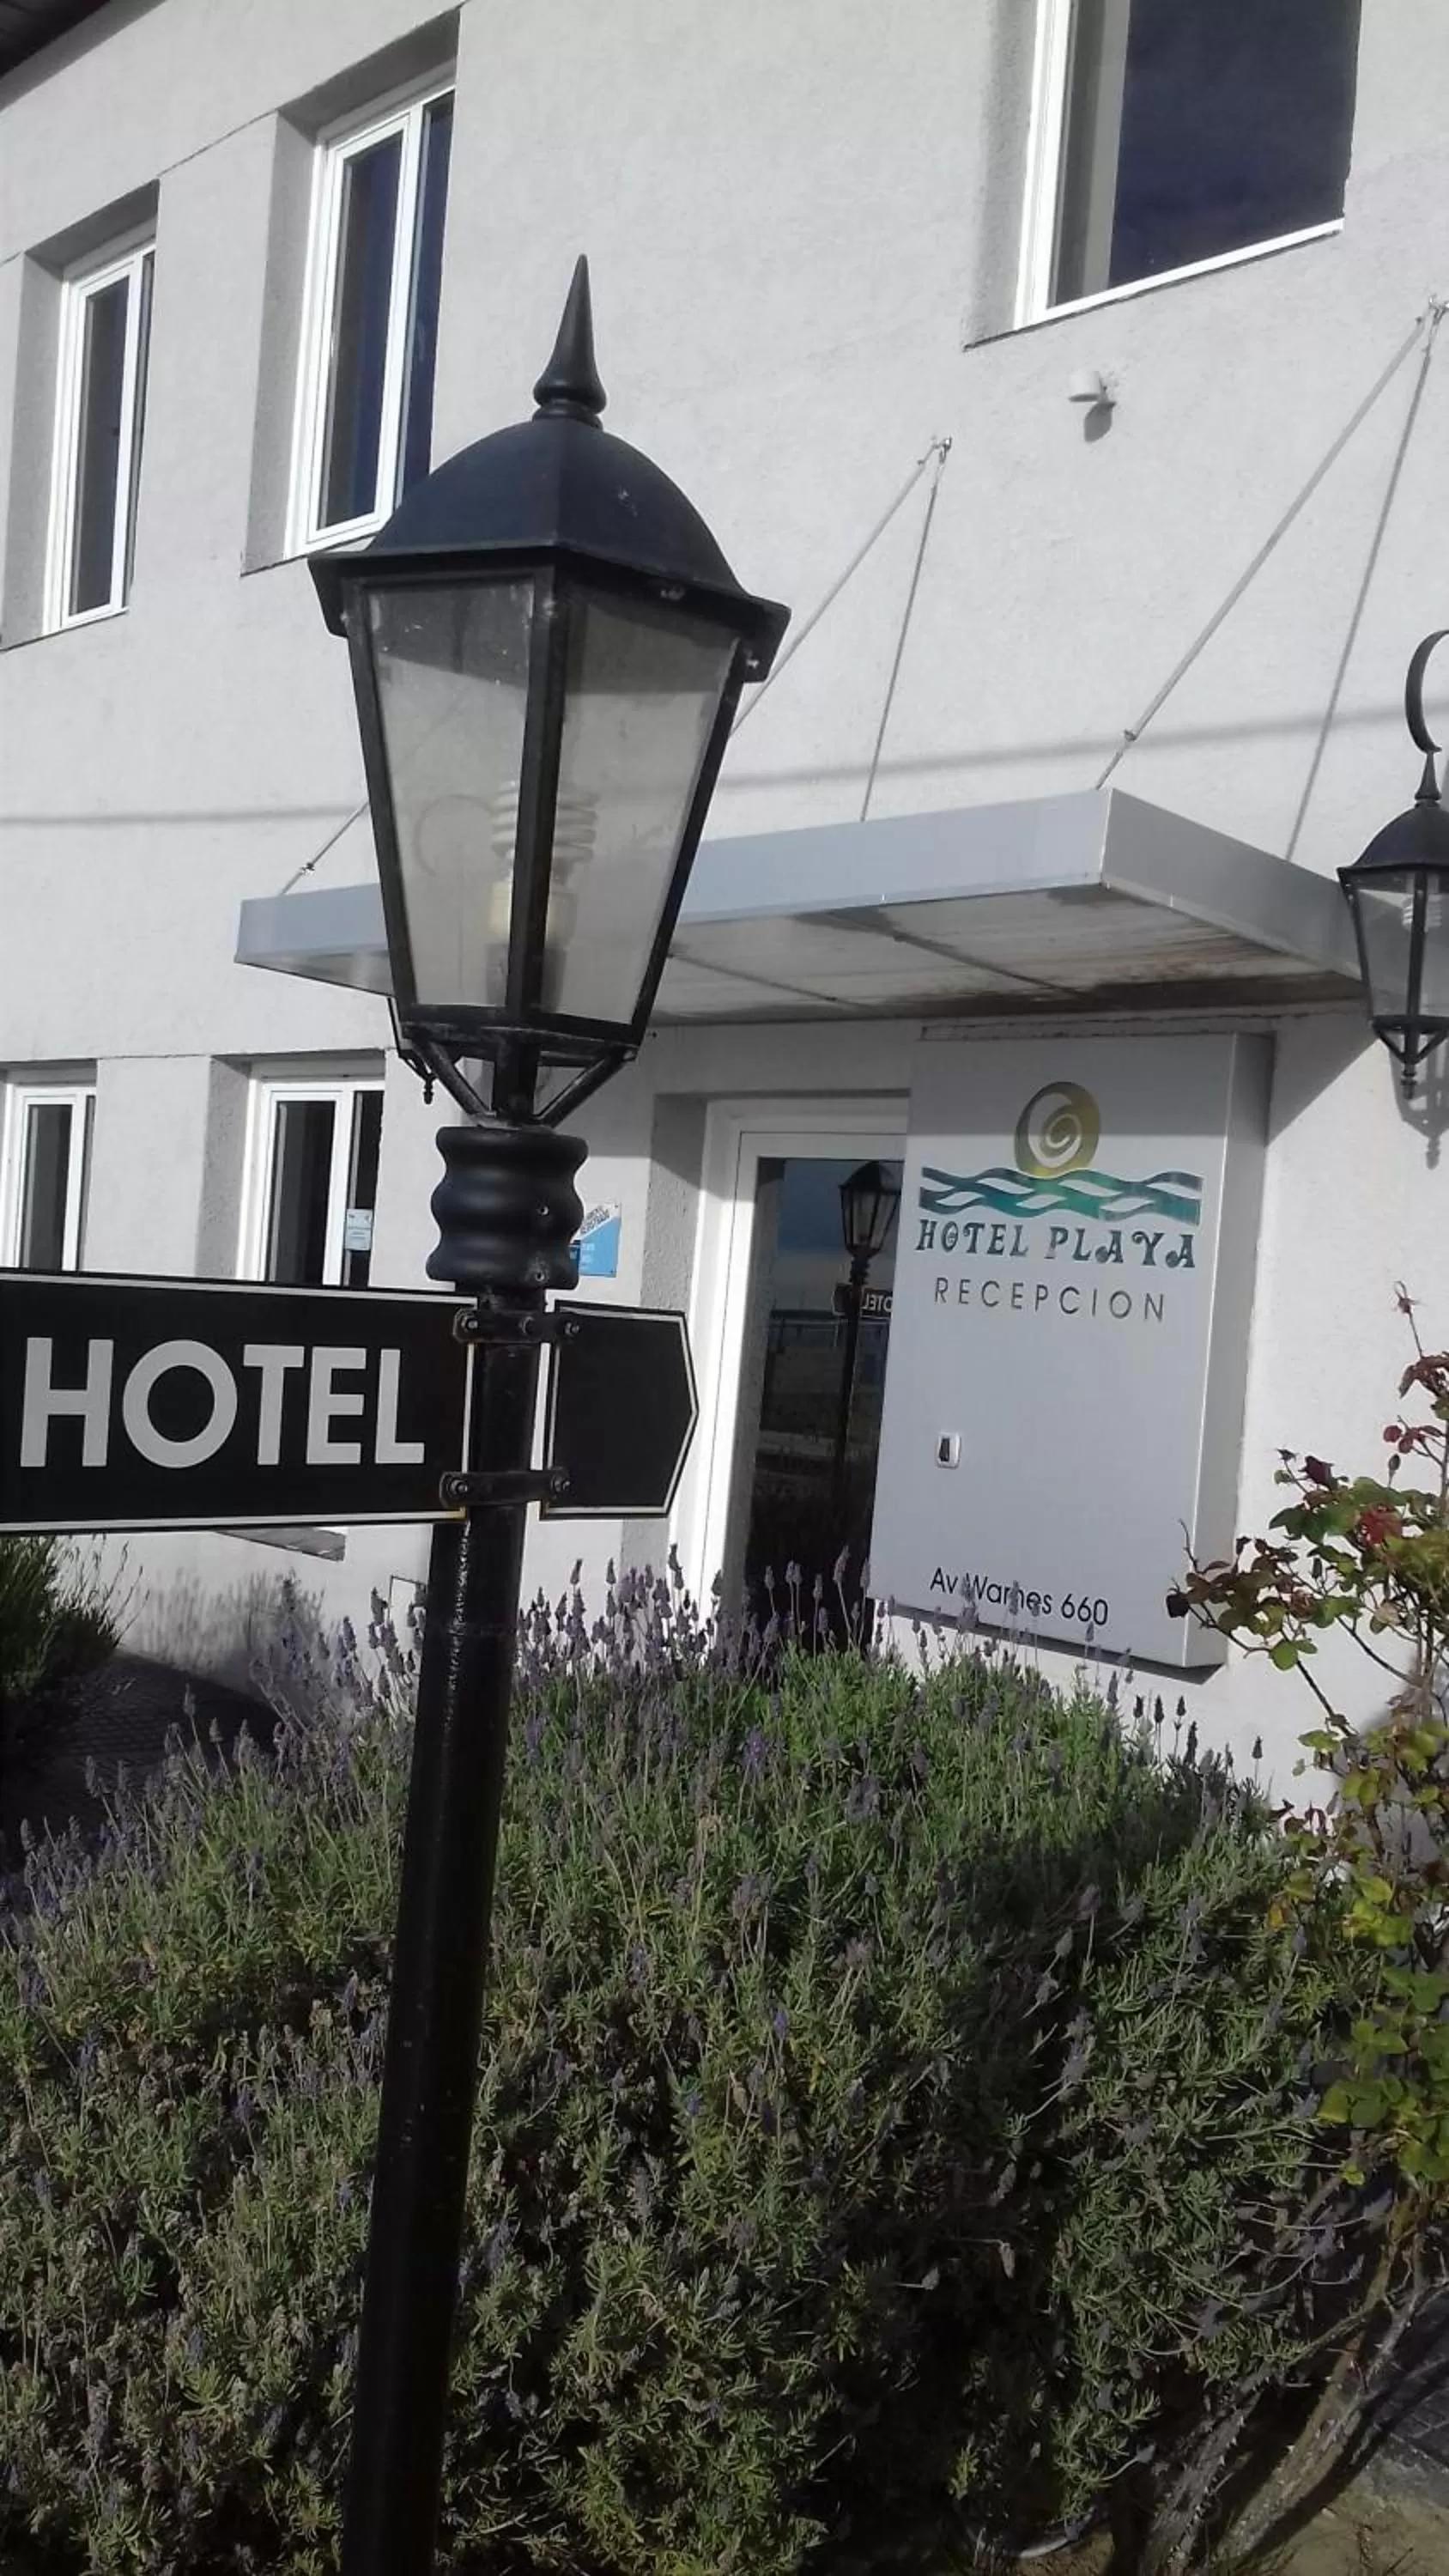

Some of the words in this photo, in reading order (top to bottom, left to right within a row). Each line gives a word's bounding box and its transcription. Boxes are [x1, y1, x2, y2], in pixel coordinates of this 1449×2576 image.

[915, 1218, 1028, 1258] HOTEL
[1043, 1225, 1196, 1268] PLAYA
[934, 1276, 1165, 1322] RECEPCION
[20, 1336, 426, 1469] HOTEL
[930, 1566, 959, 1595] Av
[1060, 1593, 1108, 1625] 660
